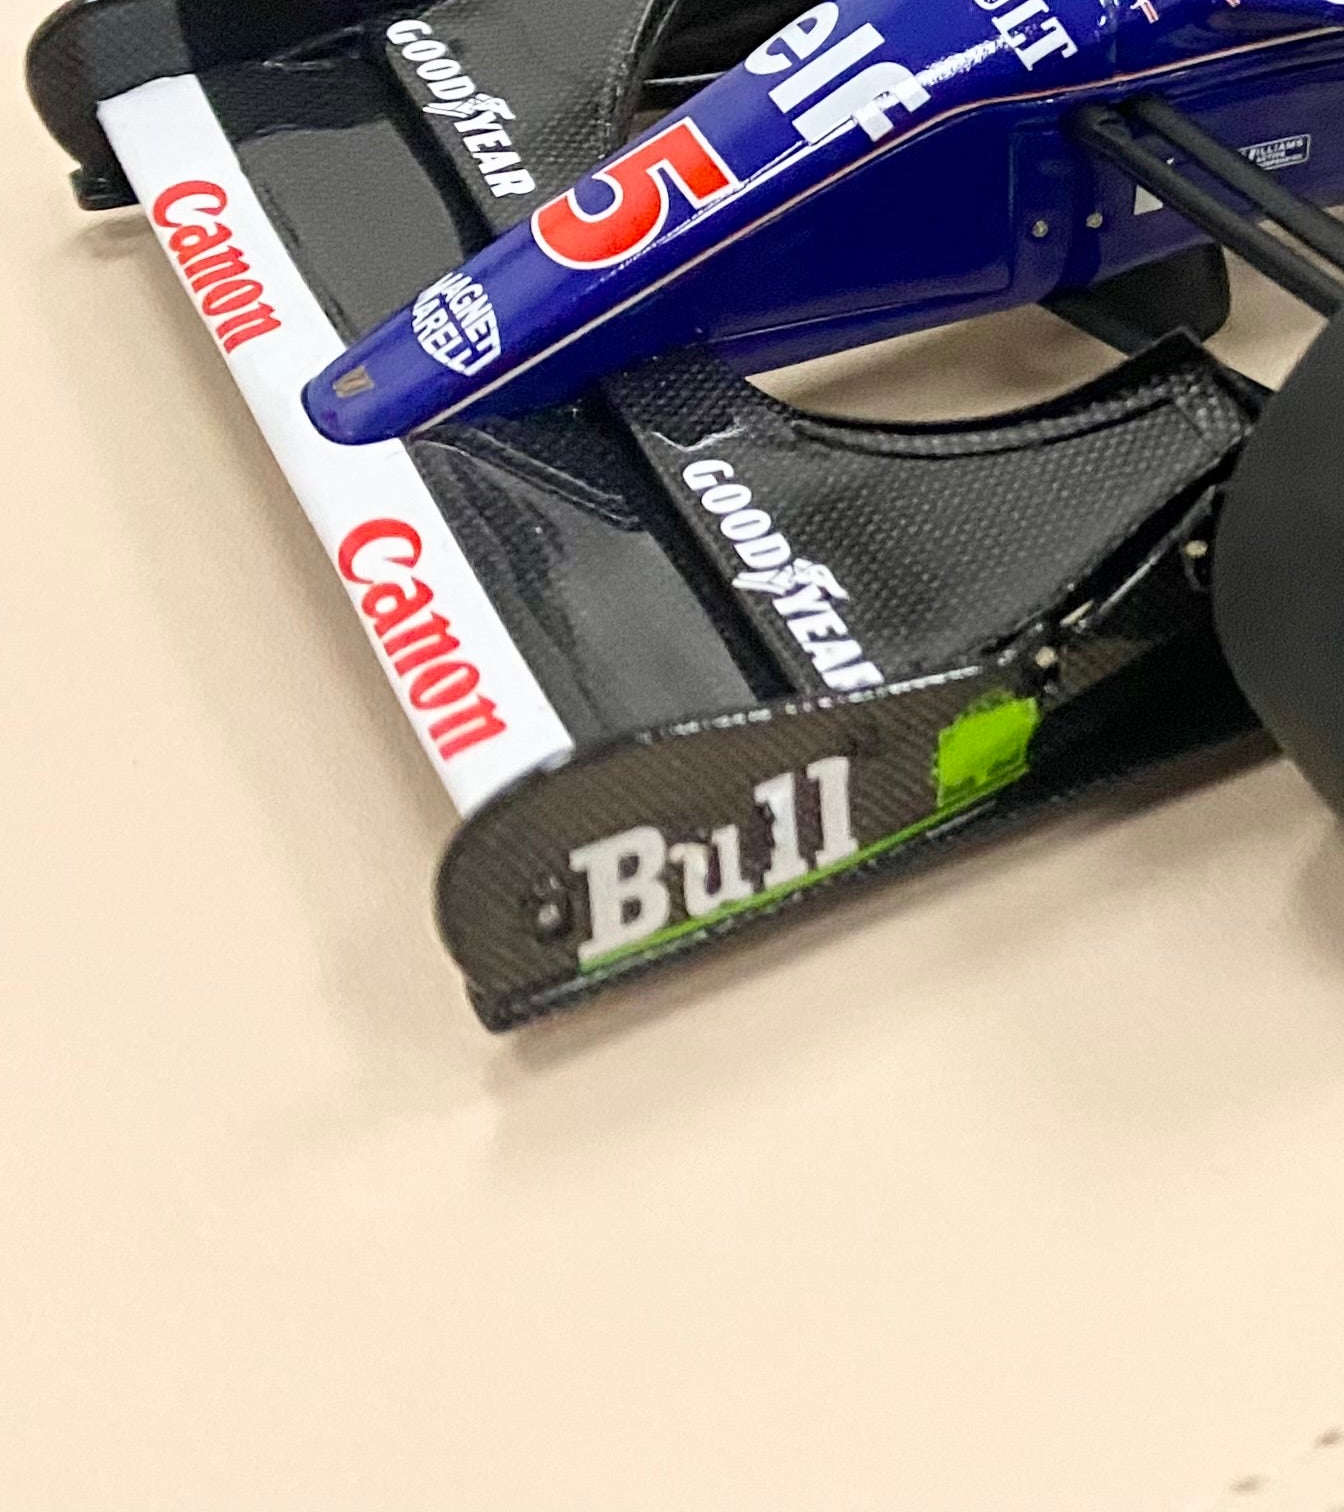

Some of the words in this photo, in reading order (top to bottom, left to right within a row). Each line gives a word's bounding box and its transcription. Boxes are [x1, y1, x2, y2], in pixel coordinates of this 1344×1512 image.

[745, 1, 931, 141] elf
[153, 180, 281, 354] Canon
[533, 120, 738, 271] 5
[337, 517, 507, 761] Canon
[569, 755, 859, 965] Bull
